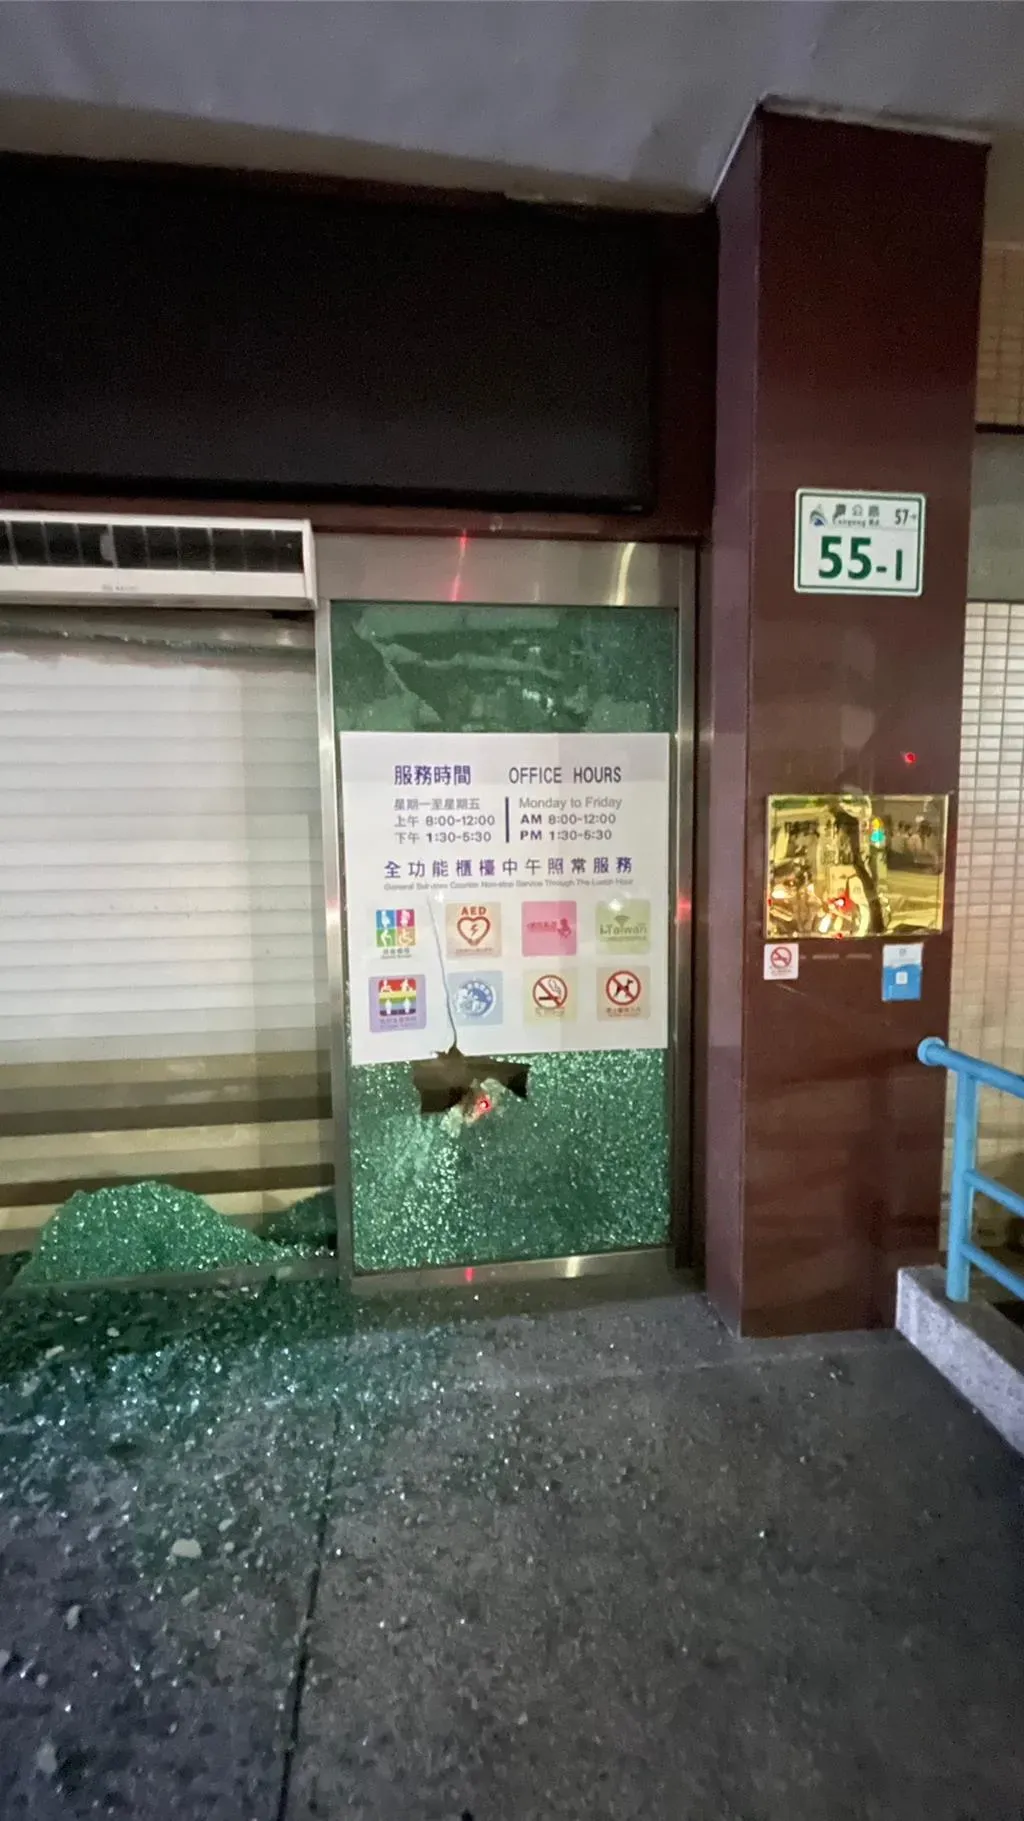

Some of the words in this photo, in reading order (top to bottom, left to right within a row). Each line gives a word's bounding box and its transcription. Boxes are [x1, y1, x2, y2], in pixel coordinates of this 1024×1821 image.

[818, 535, 903, 581] 55-1
[394, 764, 471, 786] 服務時間
[508, 766, 563, 784] OFFICE
[573, 766, 622, 784] HOURS
[394, 798, 480, 811] 星期一至星期五
[519, 797, 567, 811] Monday
[570, 798, 582, 808] to
[585, 797, 623, 810] Friday
[394, 815, 419, 828] 上午
[425, 815, 495, 827] 8:00-12:00
[520, 814, 542, 825] AM
[548, 813, 616, 825] 8:00-12:00
[394, 832, 420, 844] 下午
[426, 831, 492, 843] 1:30-5:30
[520, 830, 542, 841] PM
[549, 829, 613, 841] 1:30-5:30
[461, 906, 487, 916] AED
